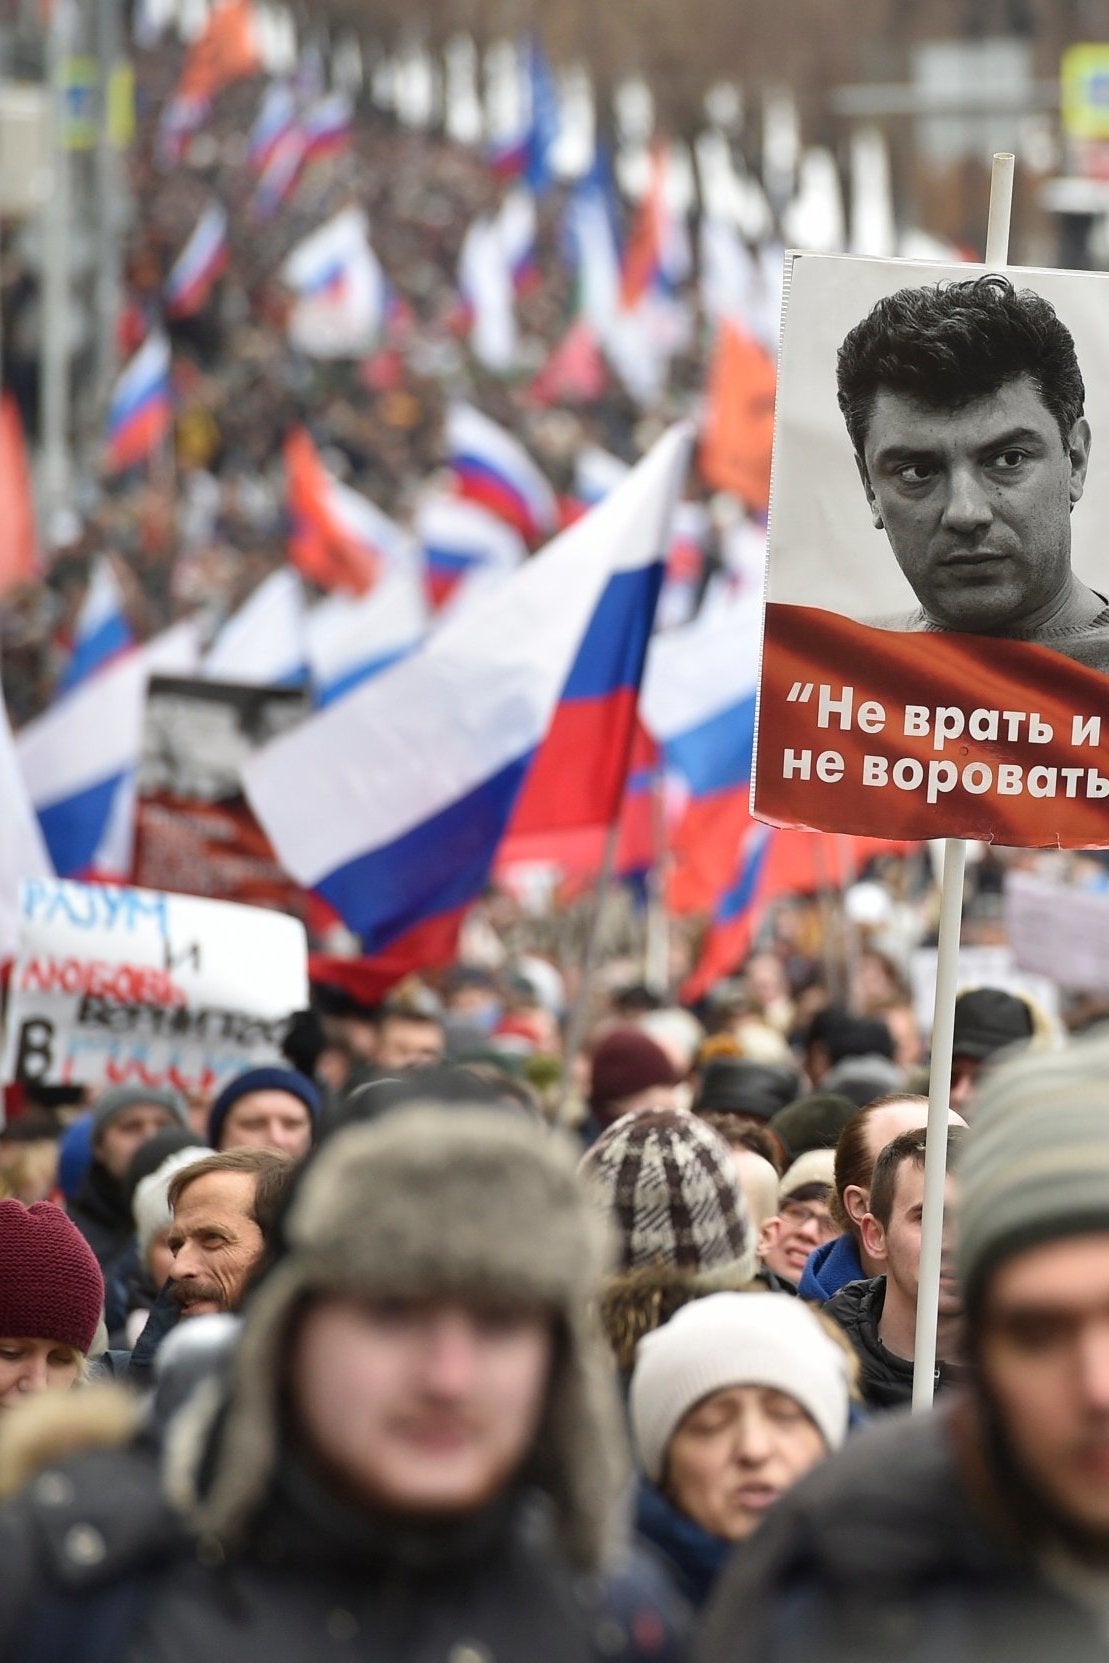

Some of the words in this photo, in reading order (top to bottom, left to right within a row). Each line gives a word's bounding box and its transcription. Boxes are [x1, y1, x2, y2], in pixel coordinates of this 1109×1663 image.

[903, 704, 1054, 751] врать
[1070, 714, 1101, 747] и
[782, 748, 846, 783] не
